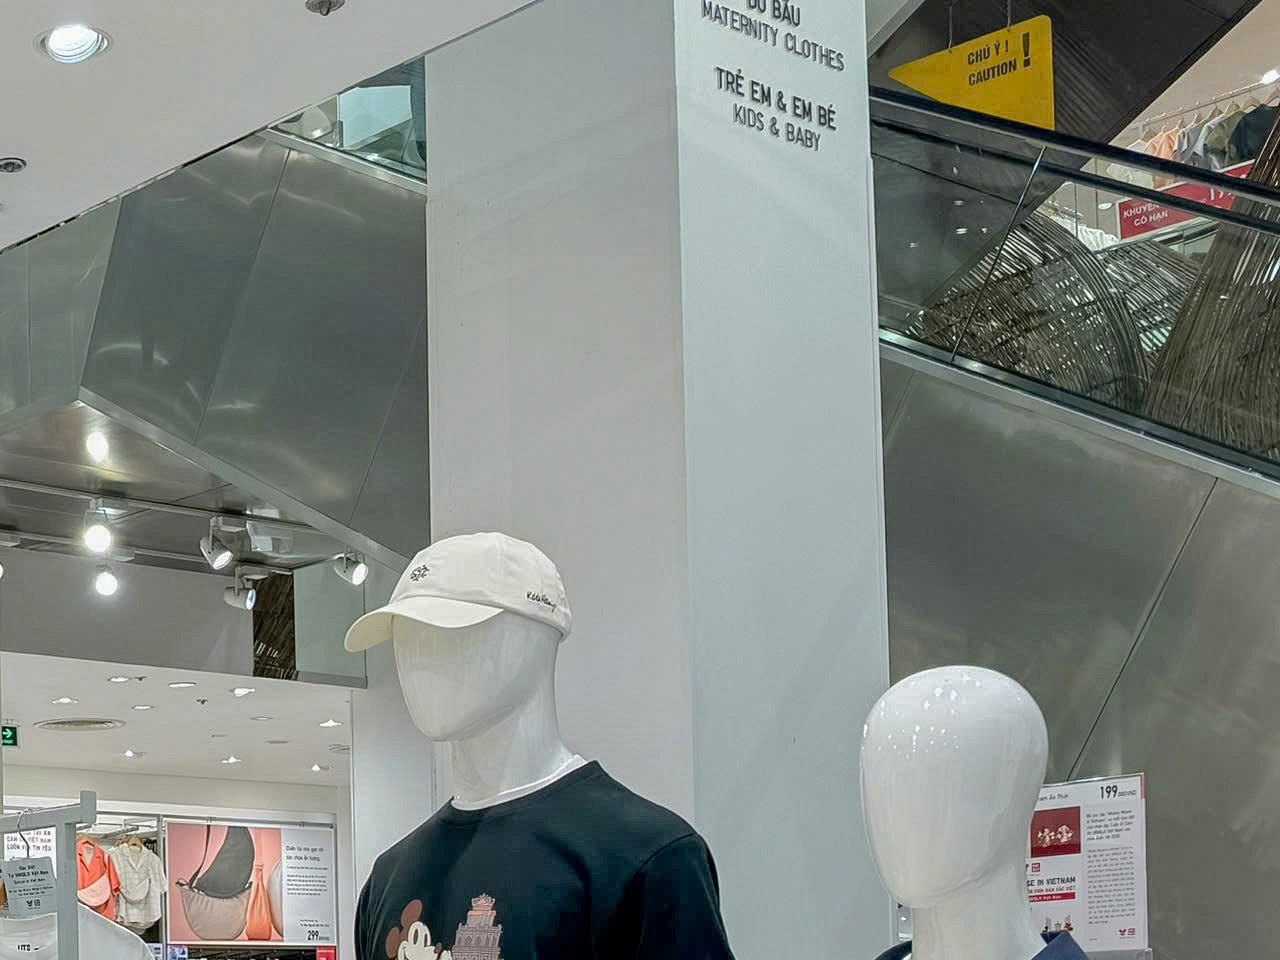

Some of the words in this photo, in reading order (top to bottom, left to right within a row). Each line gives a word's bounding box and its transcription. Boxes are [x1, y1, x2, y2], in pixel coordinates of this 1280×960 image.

[702, 0, 779, 47] MATERNITY
[785, 32, 845, 72] CLOTHES
[968, 57, 1017, 86] CAUTION
[715, 68, 745, 97] TRẺ
[751, 79, 771, 108] EM
[776, 90, 787, 113] &
[793, 96, 813, 122] EM
[818, 104, 837, 131] BÉ
[733, 103, 765, 131] KIDS
[770, 116, 780, 138] &
[786, 122, 821, 152] BABY
[1100, 785, 1118, 799] 199
[307, 930, 319, 941] 299
